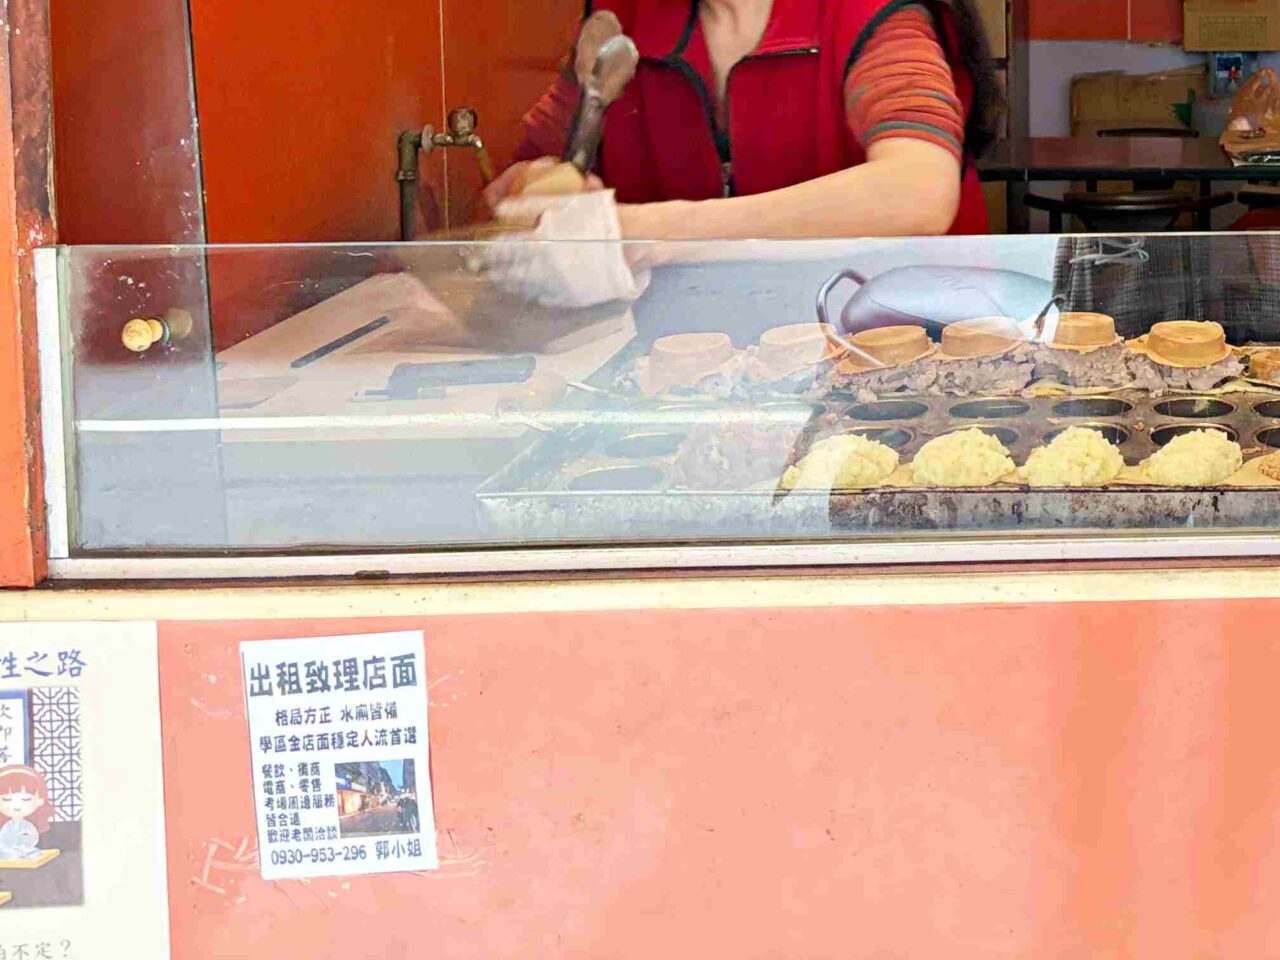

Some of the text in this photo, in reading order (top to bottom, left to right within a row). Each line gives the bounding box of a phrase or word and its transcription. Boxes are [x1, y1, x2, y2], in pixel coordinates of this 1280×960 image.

[250, 653, 418, 698] 出租致理店面
[275, 706, 332, 727] 格局方正
[259, 726, 417, 754] 學區金店面穩定人流首選
[271, 839, 423, 866] 0930-953-296 郭小姐
